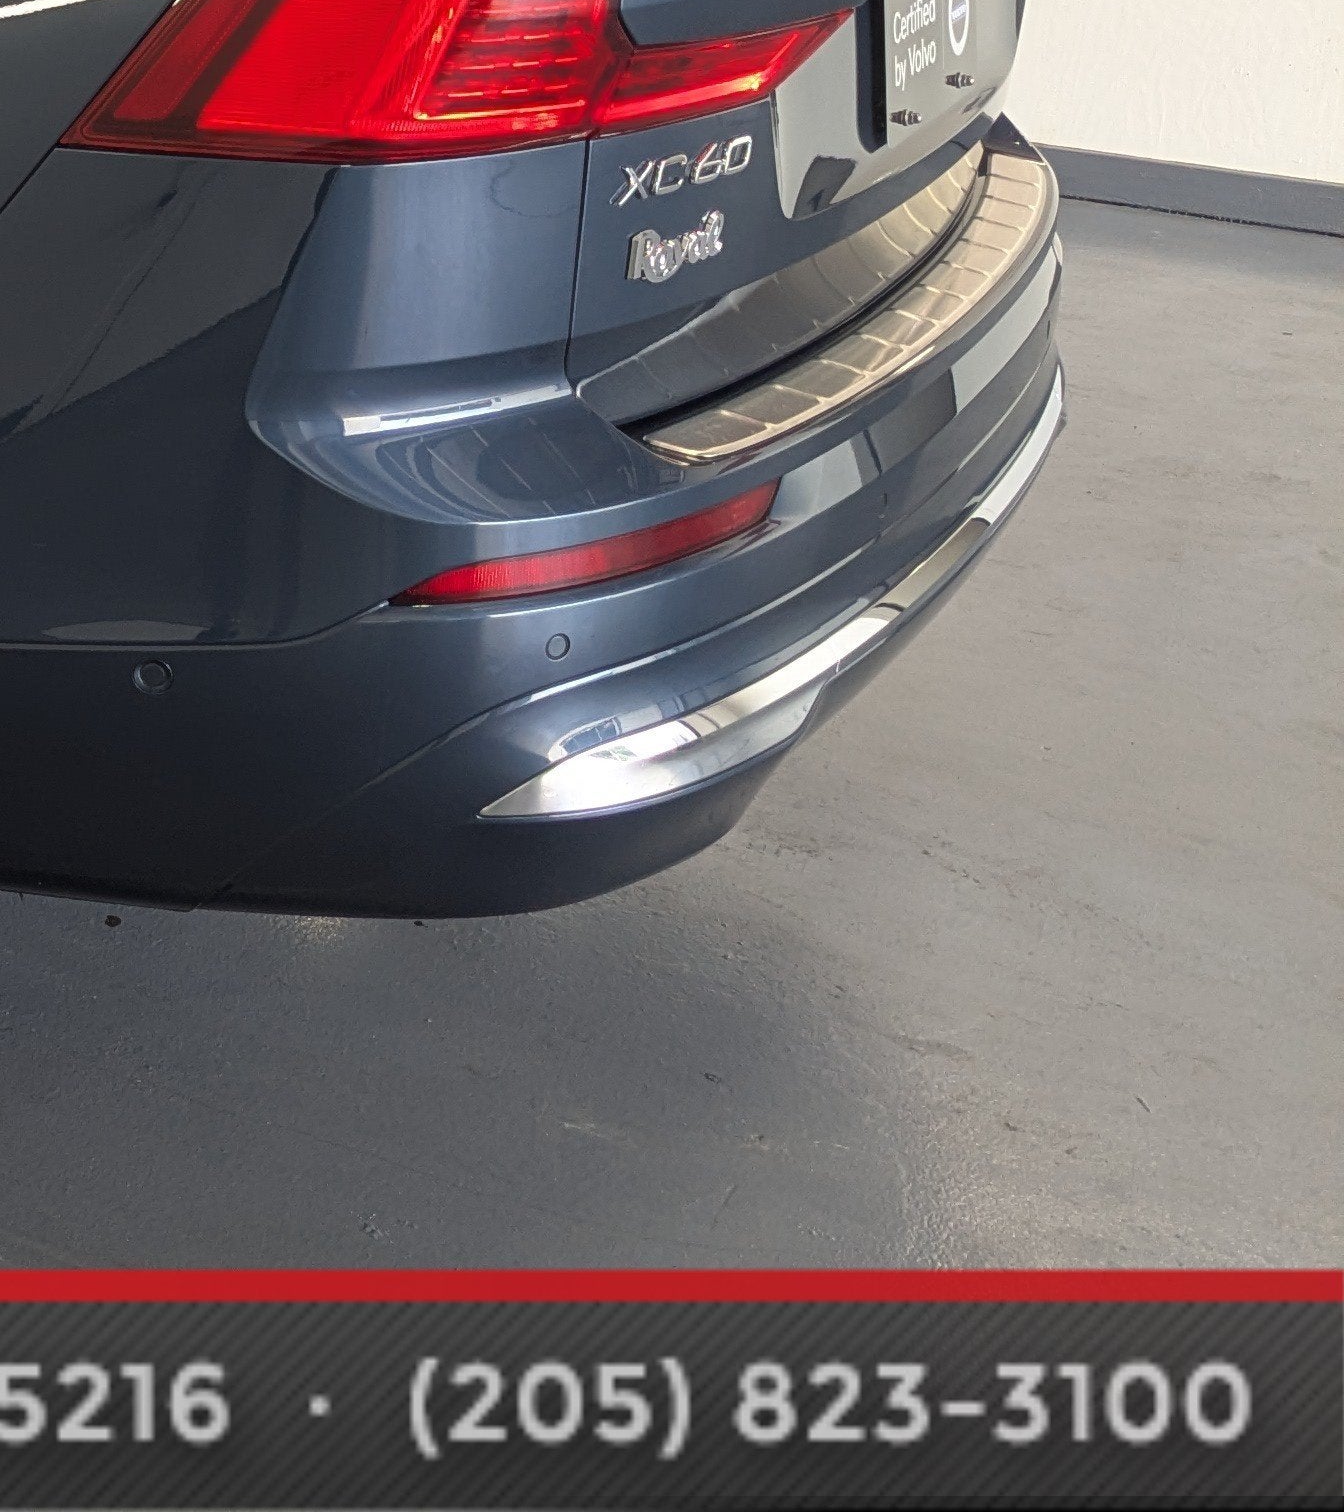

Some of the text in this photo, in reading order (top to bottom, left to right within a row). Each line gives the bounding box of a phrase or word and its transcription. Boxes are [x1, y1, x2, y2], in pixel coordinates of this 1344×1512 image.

[894, 38, 937, 91] by Volvo
[609, 135, 753, 206] XC60
[624, 209, 725, 284] Royal
